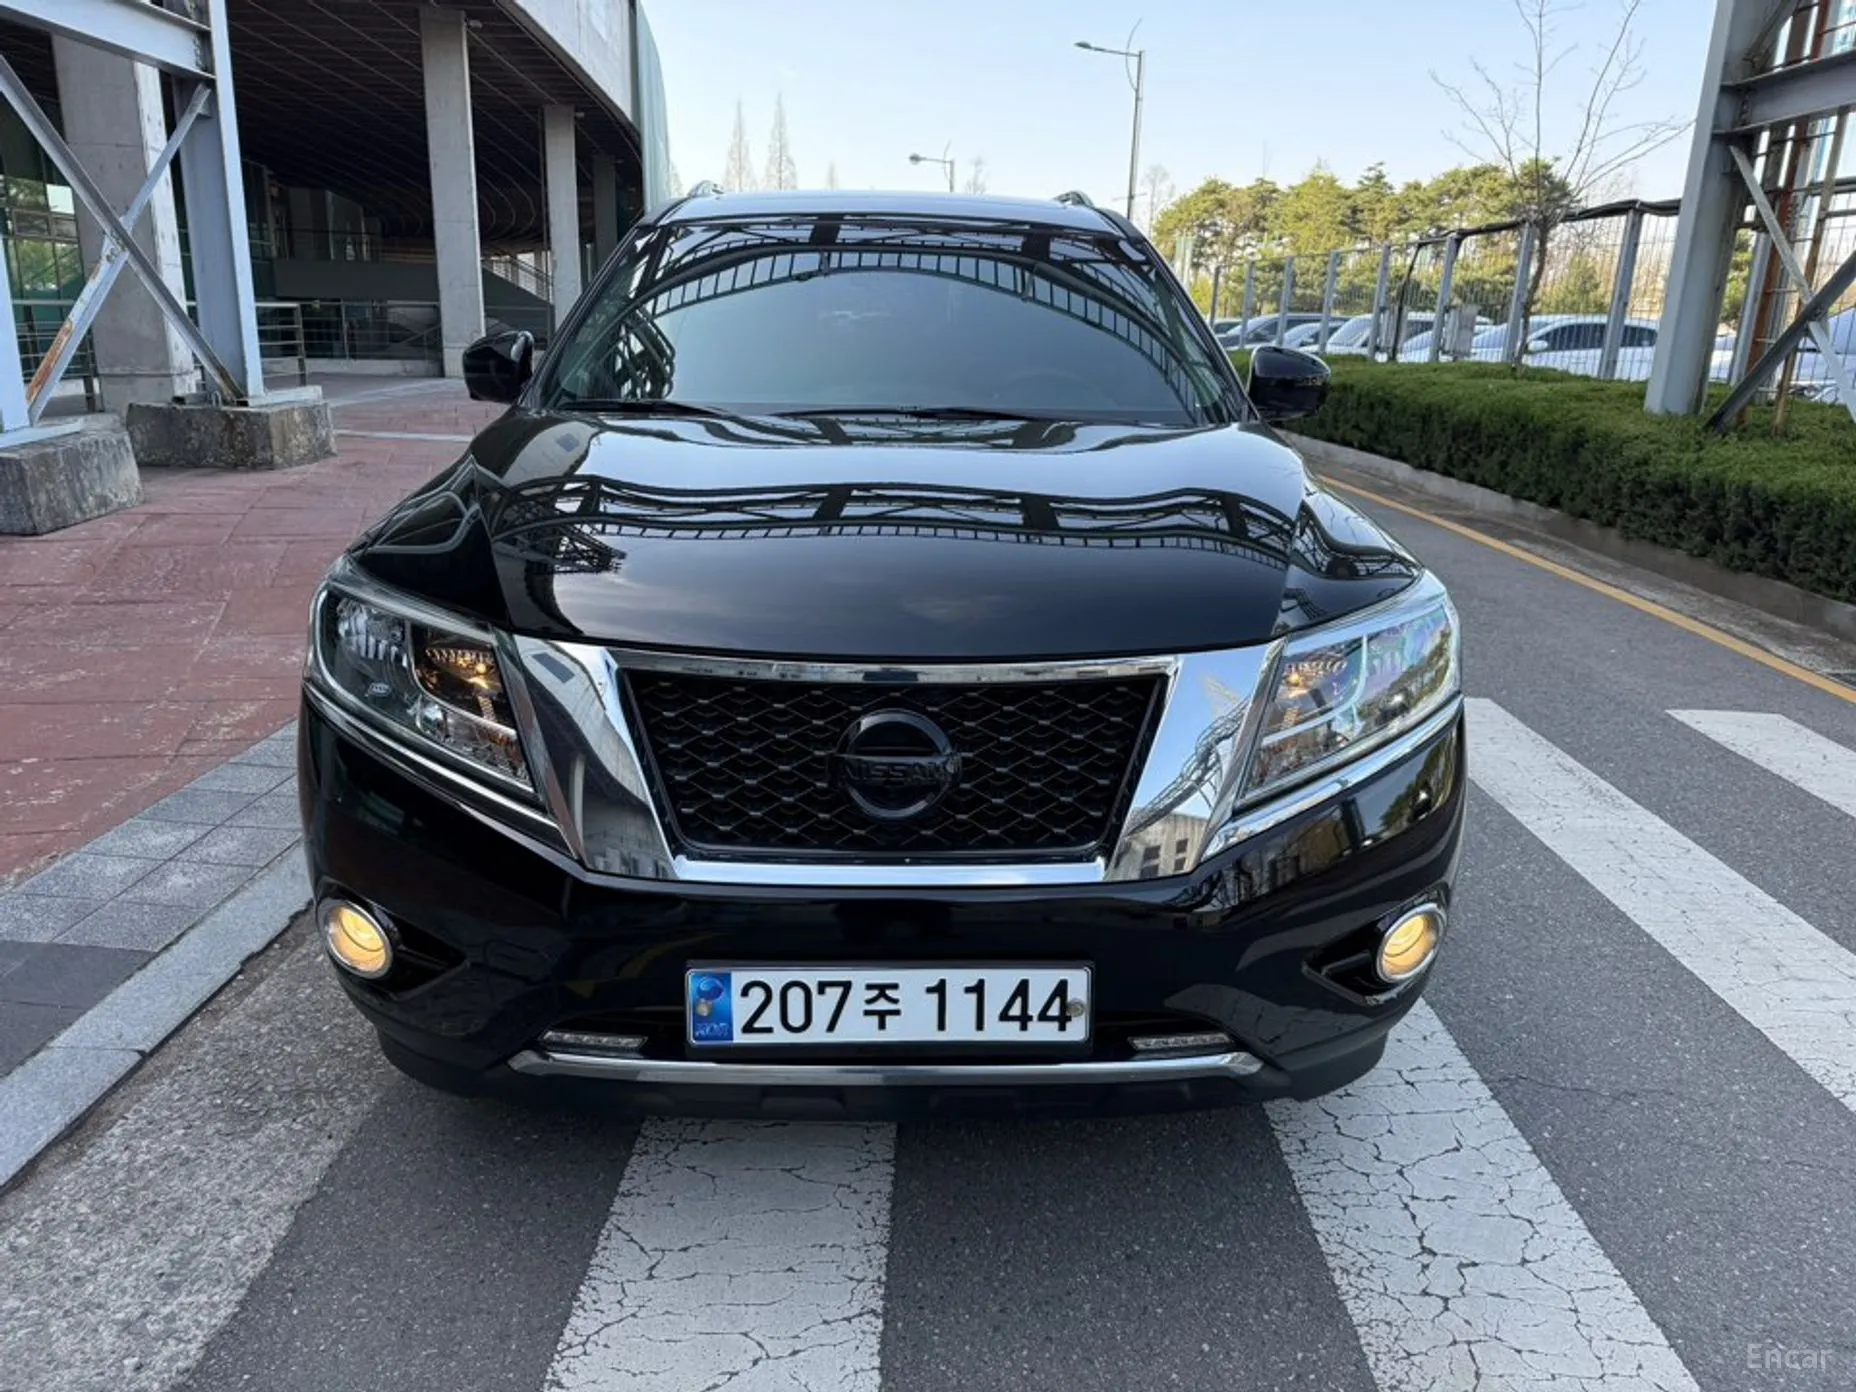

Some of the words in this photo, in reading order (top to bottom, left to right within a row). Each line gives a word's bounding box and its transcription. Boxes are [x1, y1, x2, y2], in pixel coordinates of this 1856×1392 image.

[844, 763, 946, 783] NISSAN
[740, 979, 901, 1034] 207주
[925, 978, 1072, 1032] 1144
